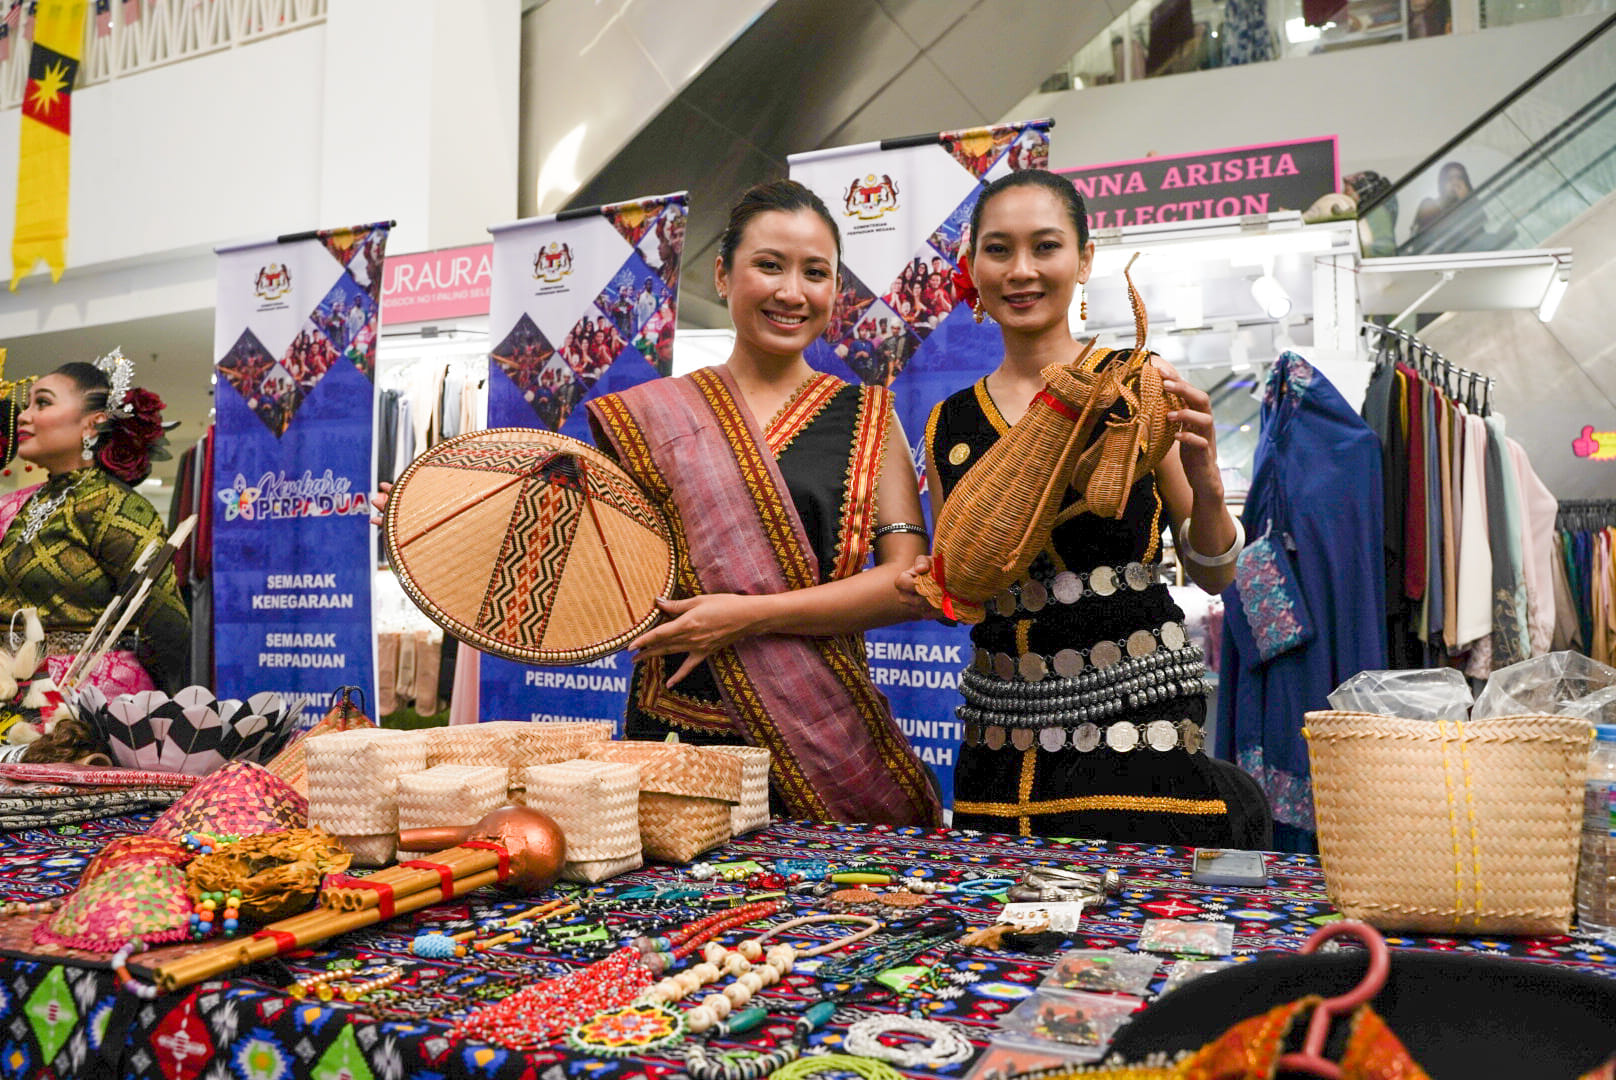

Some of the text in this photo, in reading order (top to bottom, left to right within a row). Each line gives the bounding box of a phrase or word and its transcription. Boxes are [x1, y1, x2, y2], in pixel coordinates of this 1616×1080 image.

[1072, 153, 1299, 198] NNA ARISHA
[1087, 193, 1270, 229] LLECTION
[257, 492, 371, 519] PERPADUA
[267, 573, 336, 589] SEMARAK
[252, 594, 353, 609] KENEGARAAN
[266, 633, 336, 648] SEMARAK
[258, 653, 345, 668] PERPADUAN
[865, 641, 961, 663] SEMARAK
[525, 670, 627, 692] PERPADUAN
